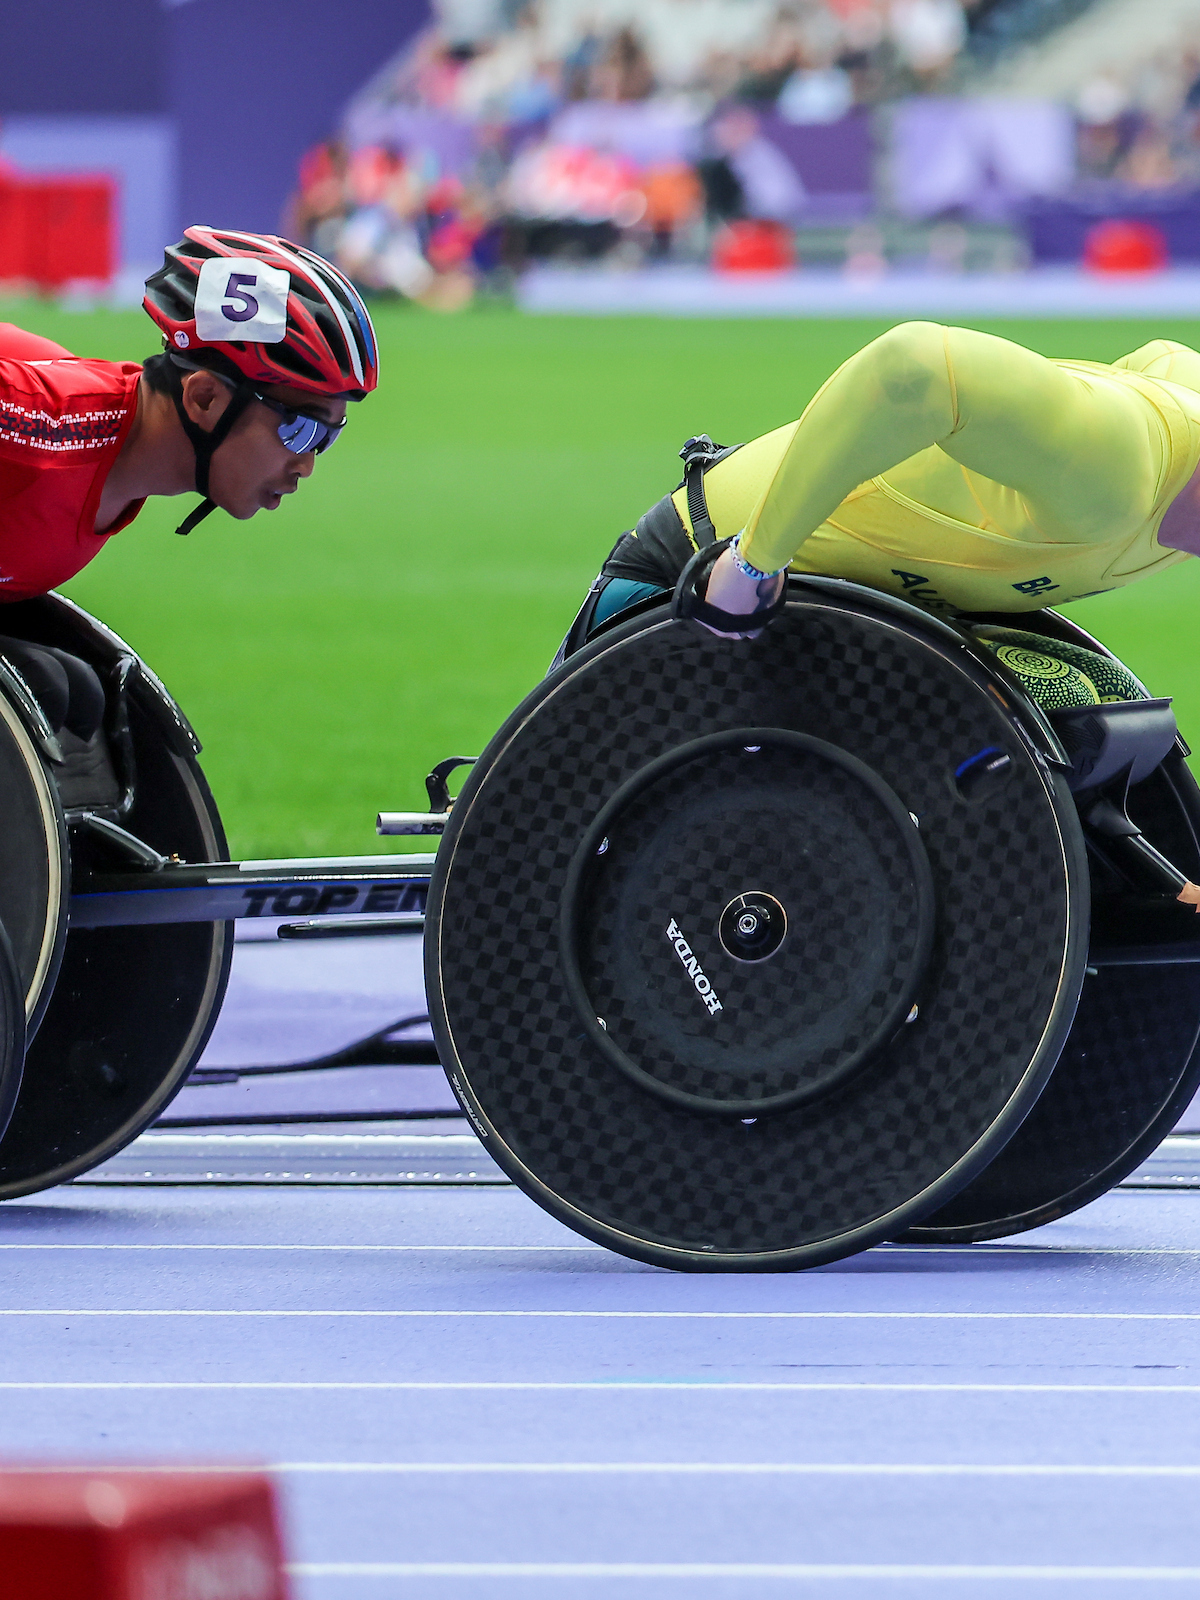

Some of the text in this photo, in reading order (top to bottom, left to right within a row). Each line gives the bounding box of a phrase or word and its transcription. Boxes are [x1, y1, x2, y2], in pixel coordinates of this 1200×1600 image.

[221, 273, 259, 322] 5
[242, 885, 359, 917] TOP
[666, 918, 723, 1015] HONDA
